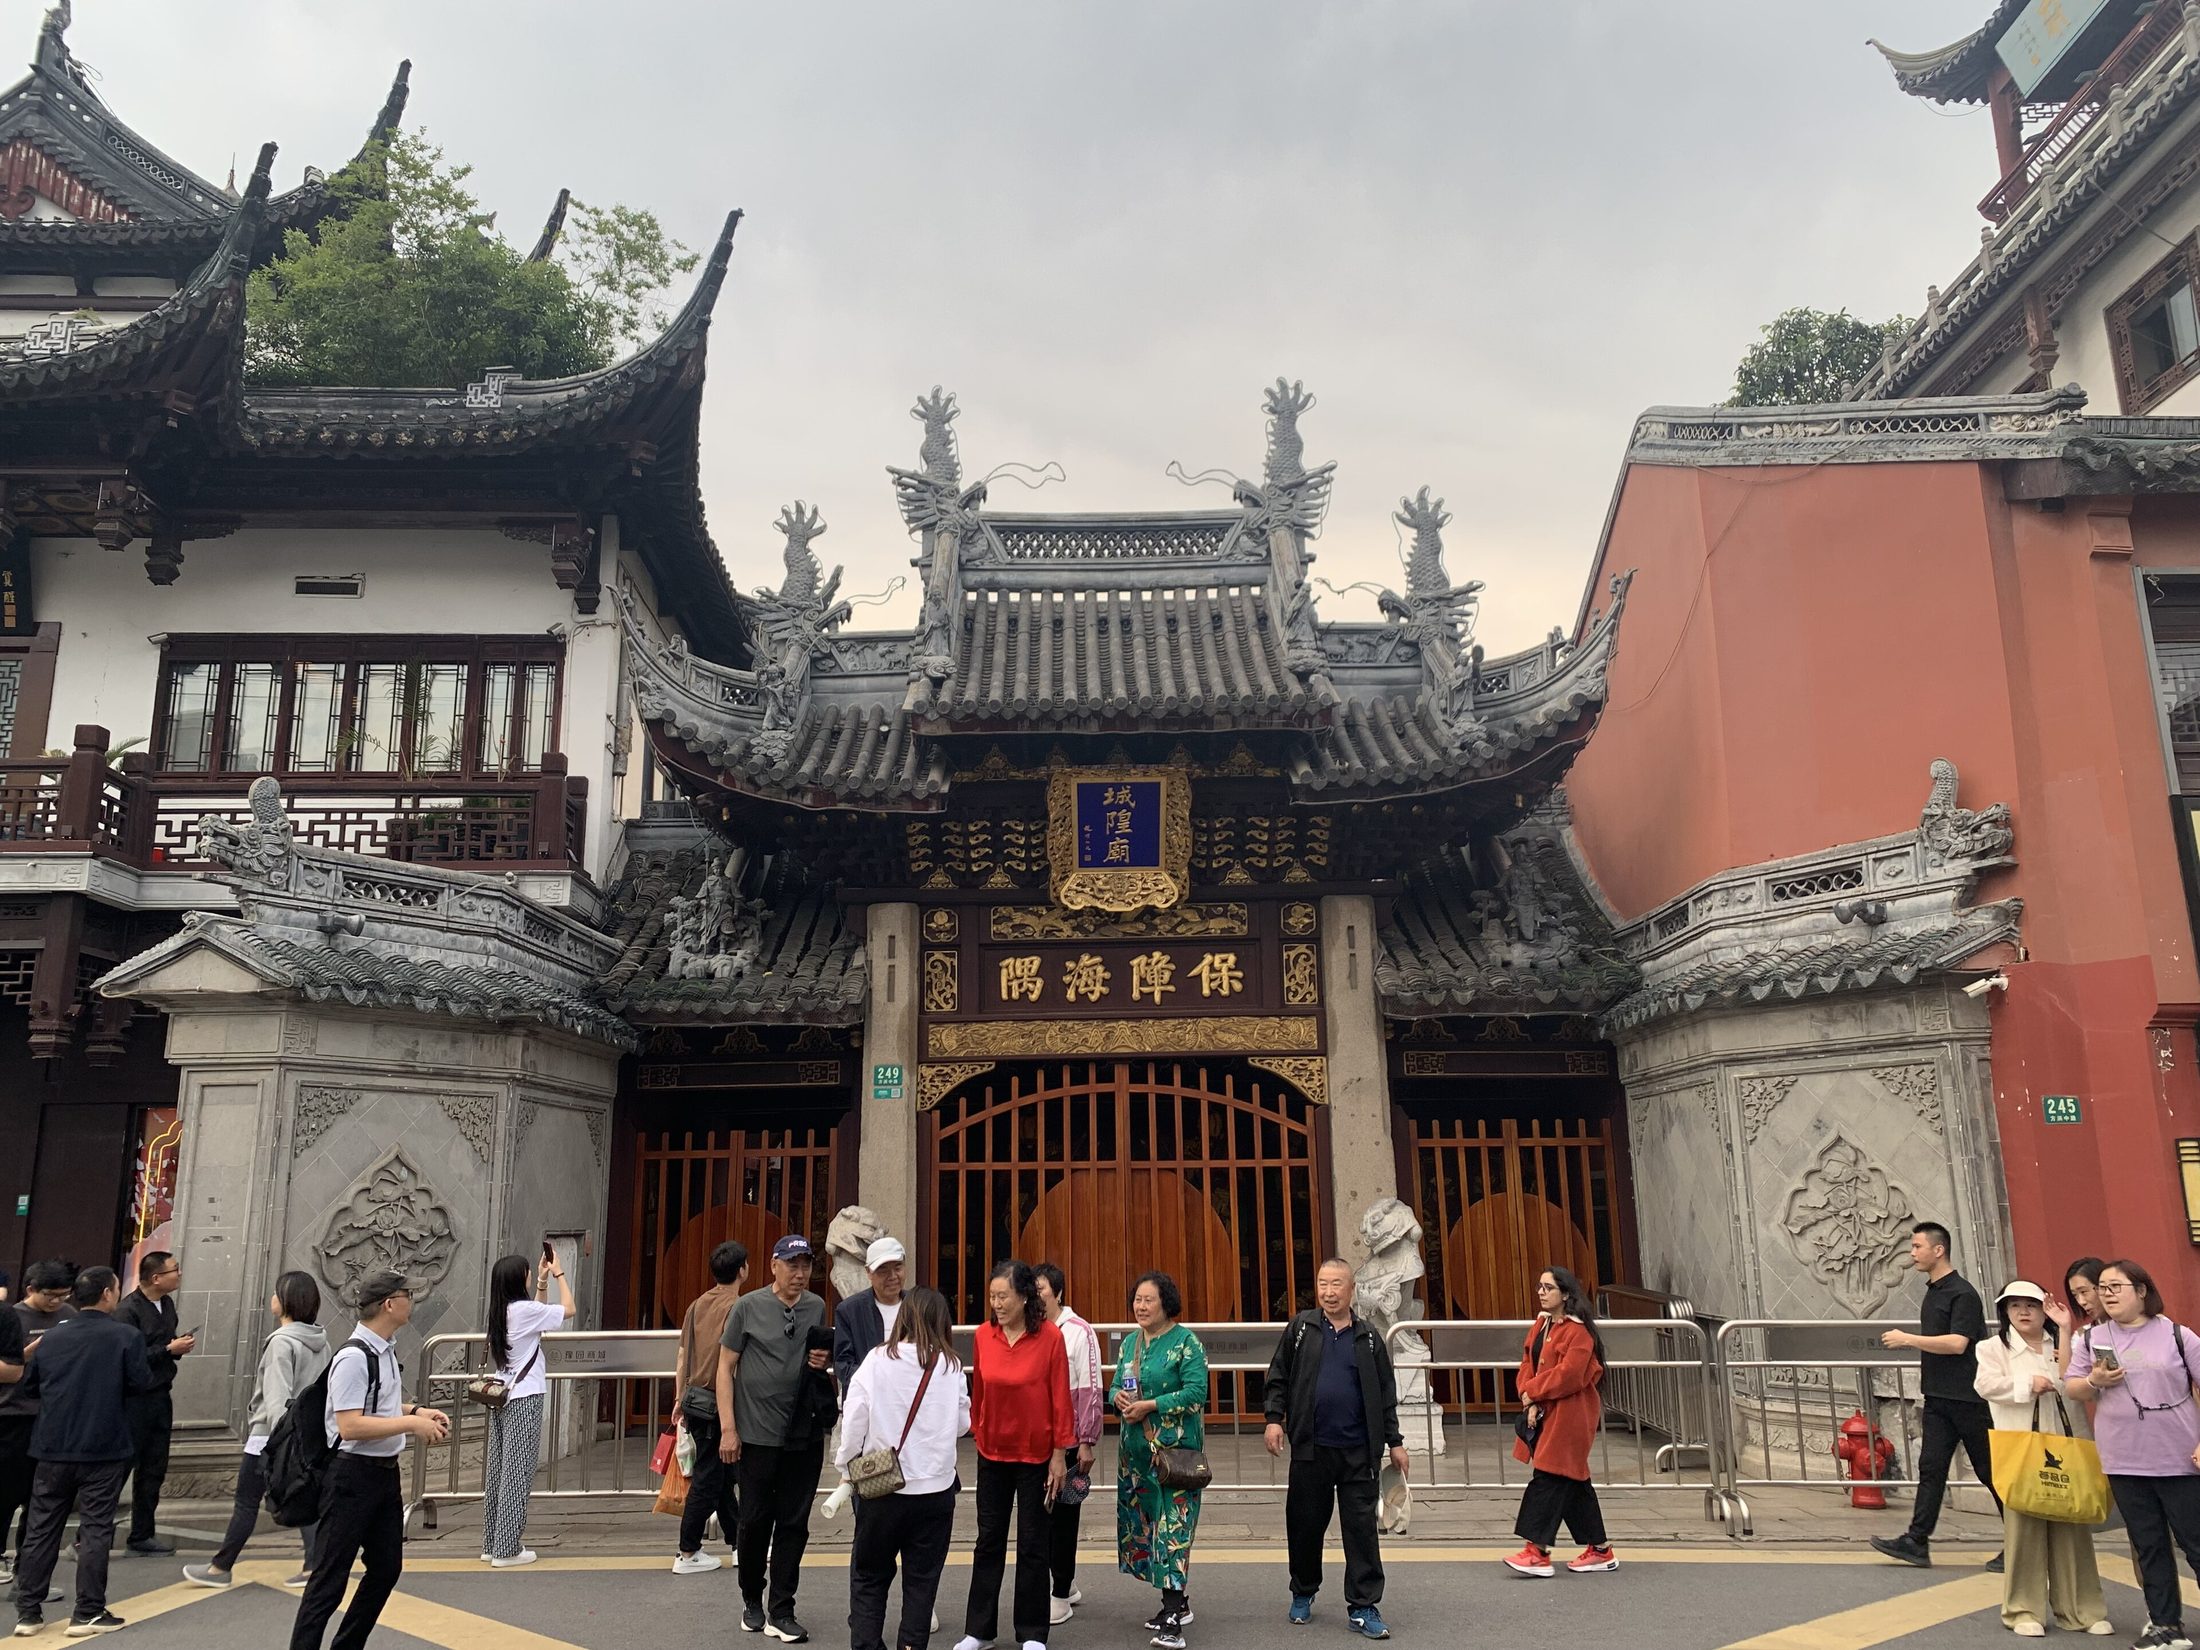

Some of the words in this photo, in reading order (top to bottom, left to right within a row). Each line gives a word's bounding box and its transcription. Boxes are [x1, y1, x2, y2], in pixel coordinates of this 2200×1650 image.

[1102, 785, 1137, 864] 城隍廟
[877, 1067, 899, 1079] 249
[2047, 1098, 2076, 1114] 245
